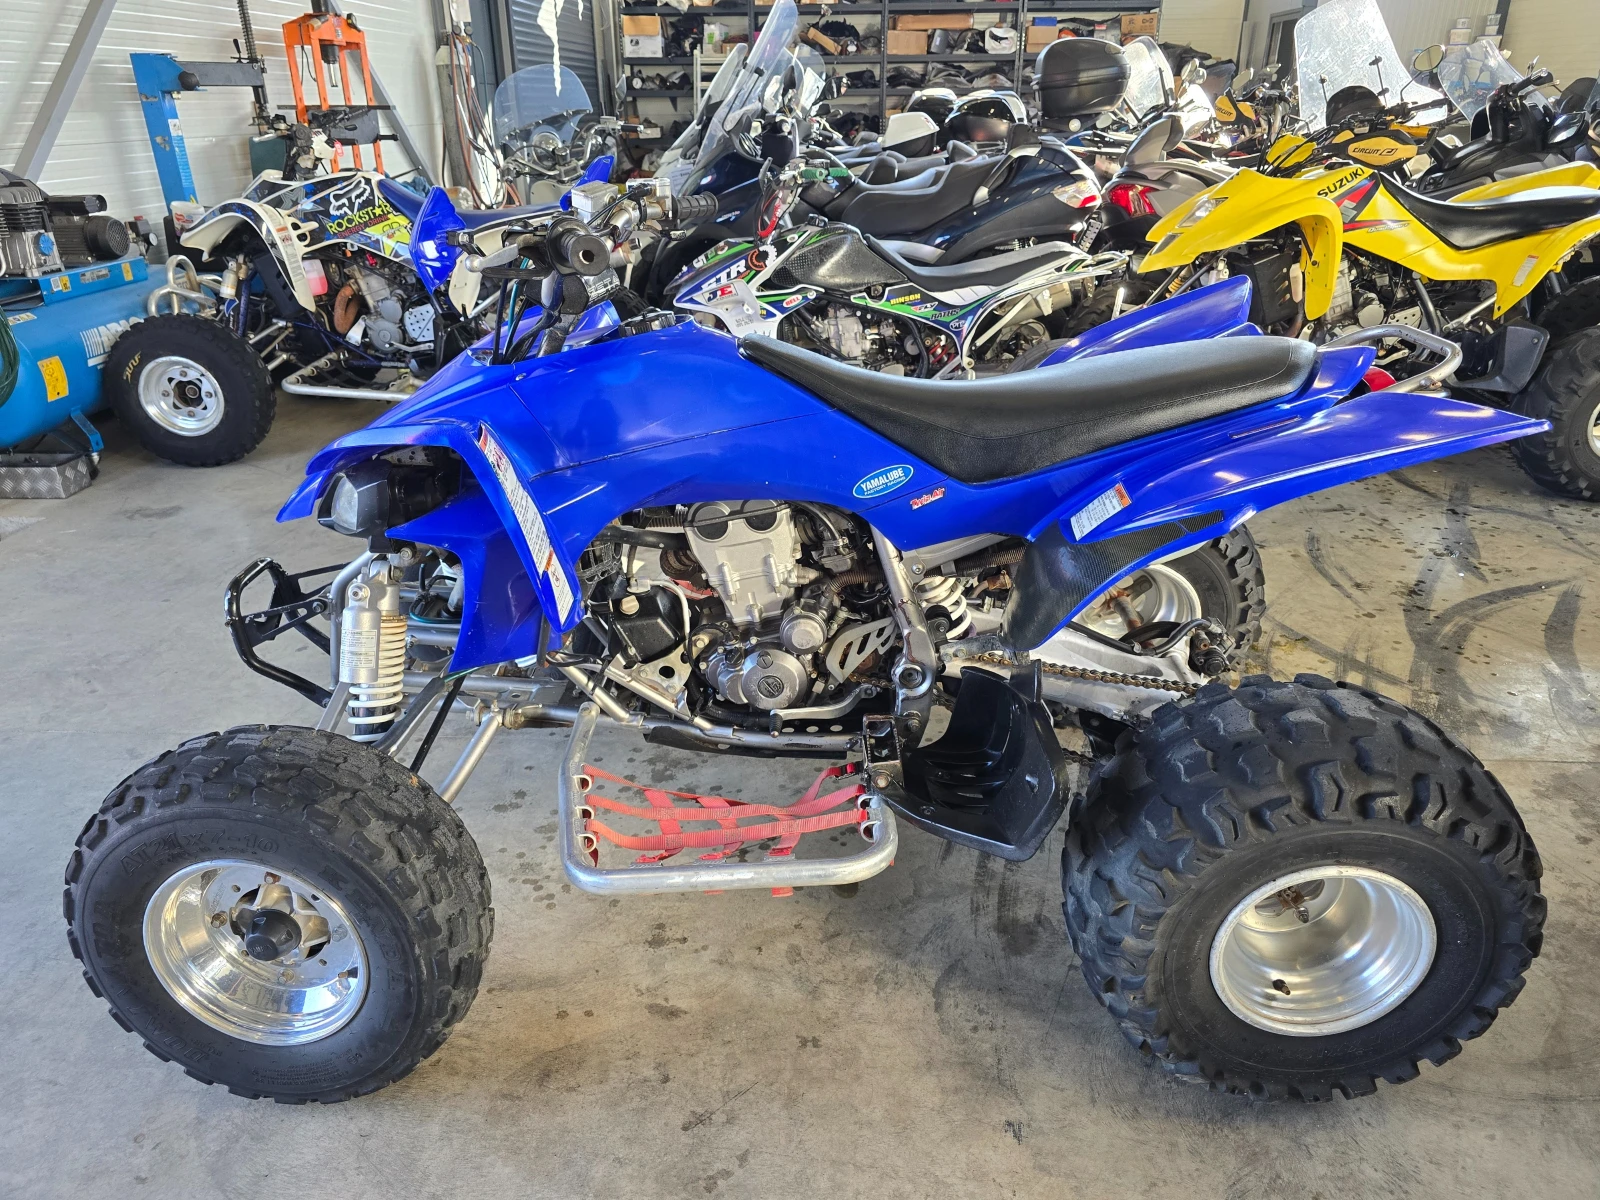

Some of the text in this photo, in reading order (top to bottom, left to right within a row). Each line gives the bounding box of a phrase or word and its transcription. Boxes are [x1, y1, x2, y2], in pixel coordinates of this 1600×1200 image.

[1352, 147, 1381, 155] CIRCUIT
[1317, 167, 1366, 197] SUZUKI
[337, 214, 390, 239] ENERGY DRINK
[707, 285, 733, 302] JE
[785, 297, 800, 306] BELL
[861, 468, 905, 491] YAMALUBE
[864, 476, 906, 495] FACTORY RACING
[931, 487, 945, 503] Air
[318, 865, 405, 992] KENDA
